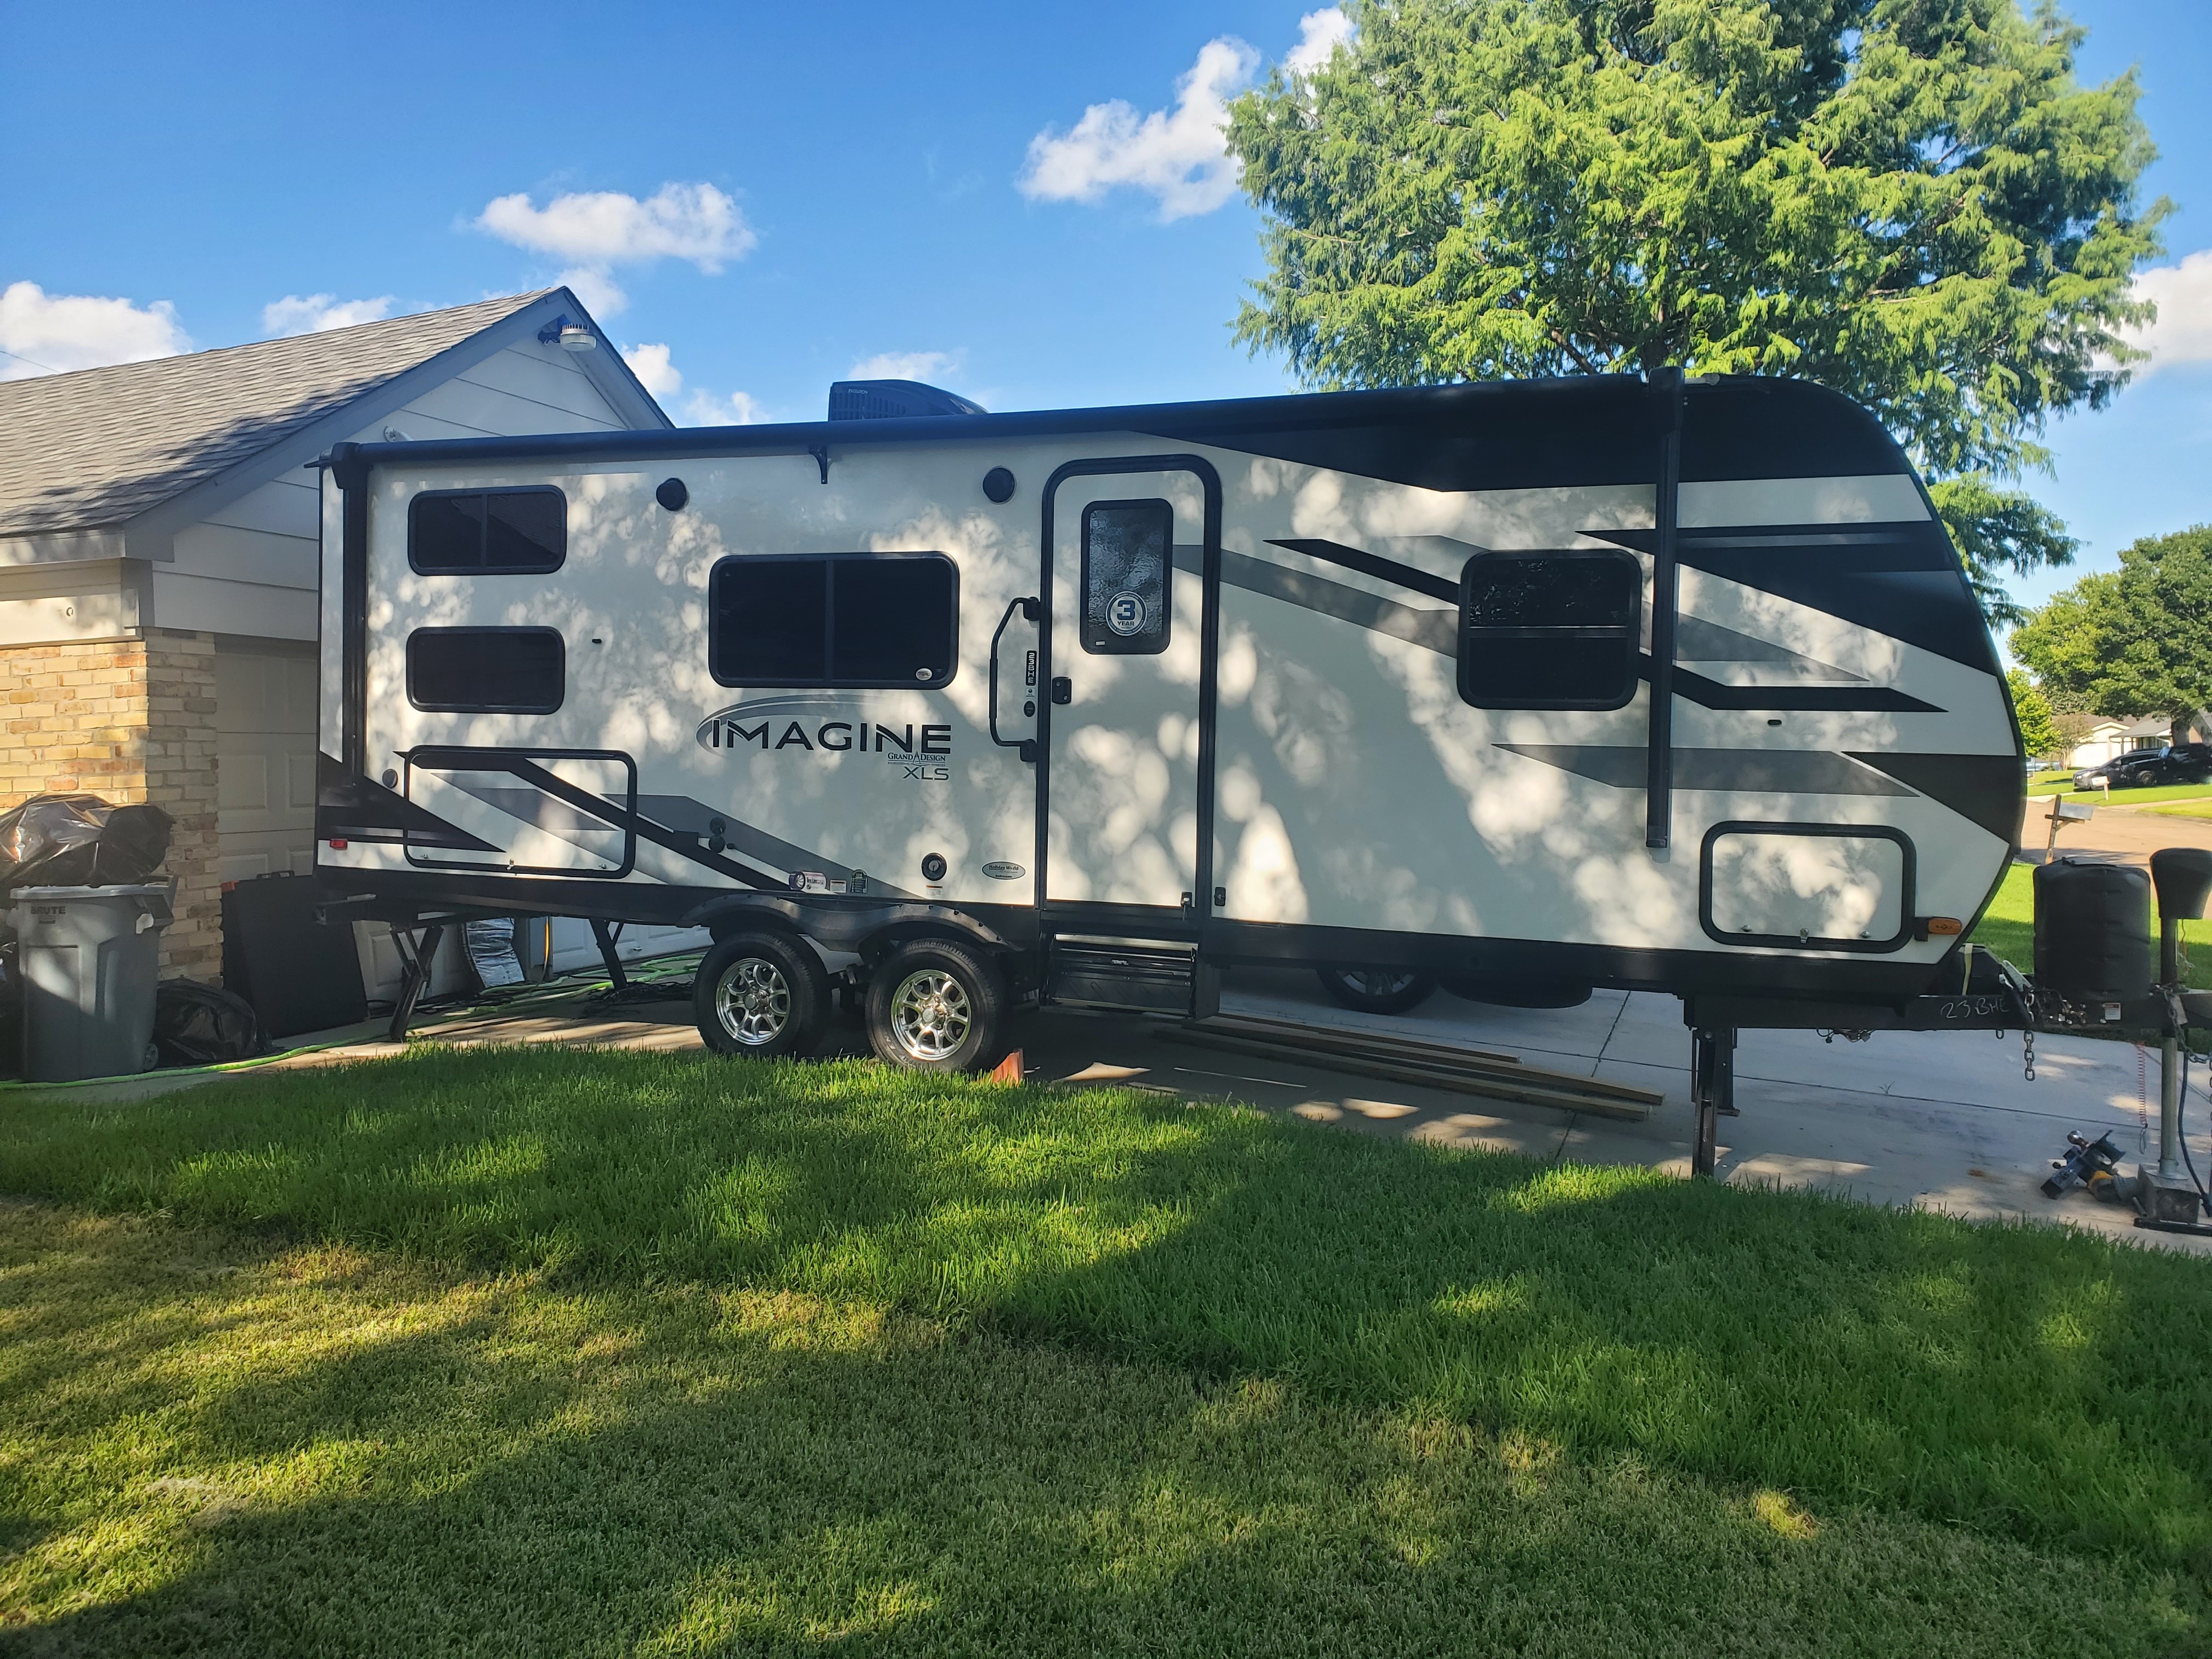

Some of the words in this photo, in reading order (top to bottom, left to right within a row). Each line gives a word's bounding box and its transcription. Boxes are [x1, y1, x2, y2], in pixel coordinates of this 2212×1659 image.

[1117, 600, 1136, 620] 3
[713, 719, 951, 754] IMAGINE
[888, 752, 913, 760] GRAND
[902, 766, 949, 781] XLS
